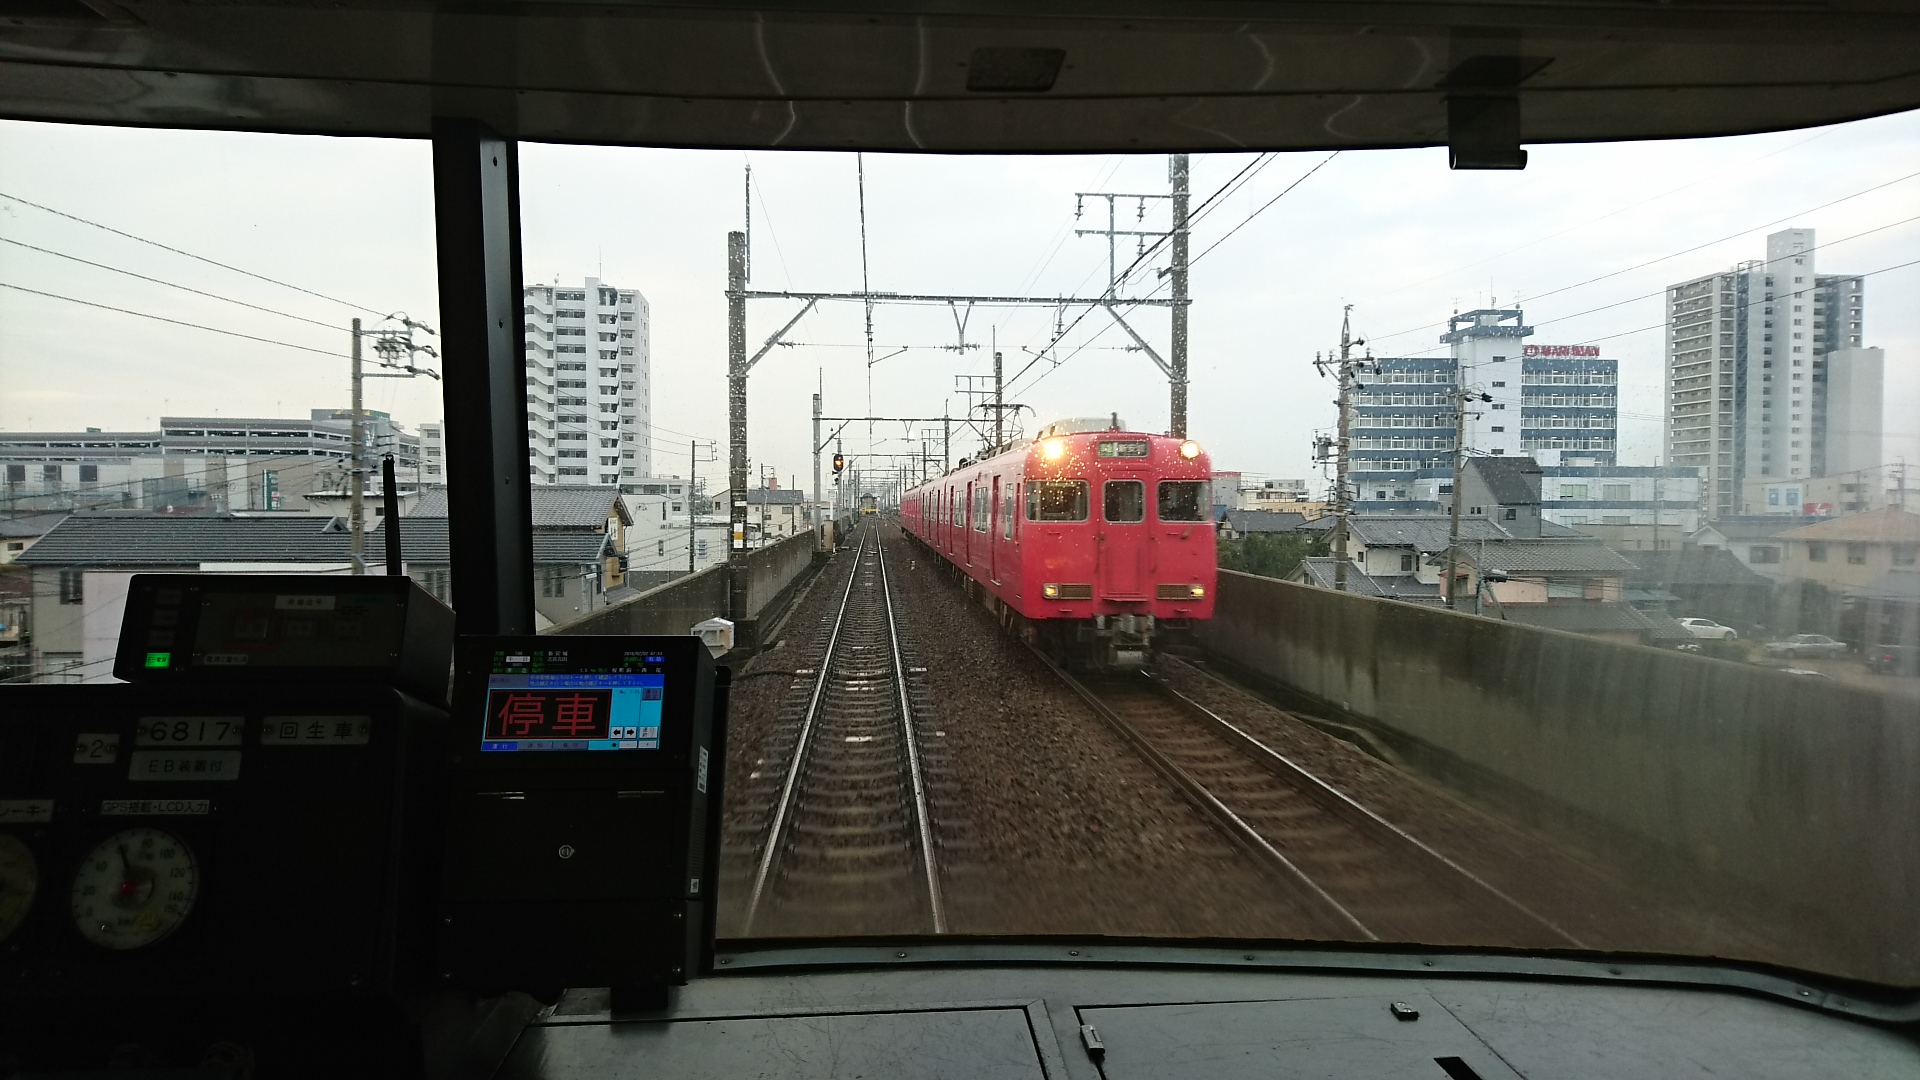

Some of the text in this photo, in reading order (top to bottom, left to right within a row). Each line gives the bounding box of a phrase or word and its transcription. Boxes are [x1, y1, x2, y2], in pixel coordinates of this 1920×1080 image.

[498, 693, 598, 735] 停車
[150, 721, 232, 741] 6817
[279, 721, 354, 740] 回生車
[90, 739, 103, 758] 2
[148, 759, 223, 773] EB装置付
[170, 867, 186, 878] 120
